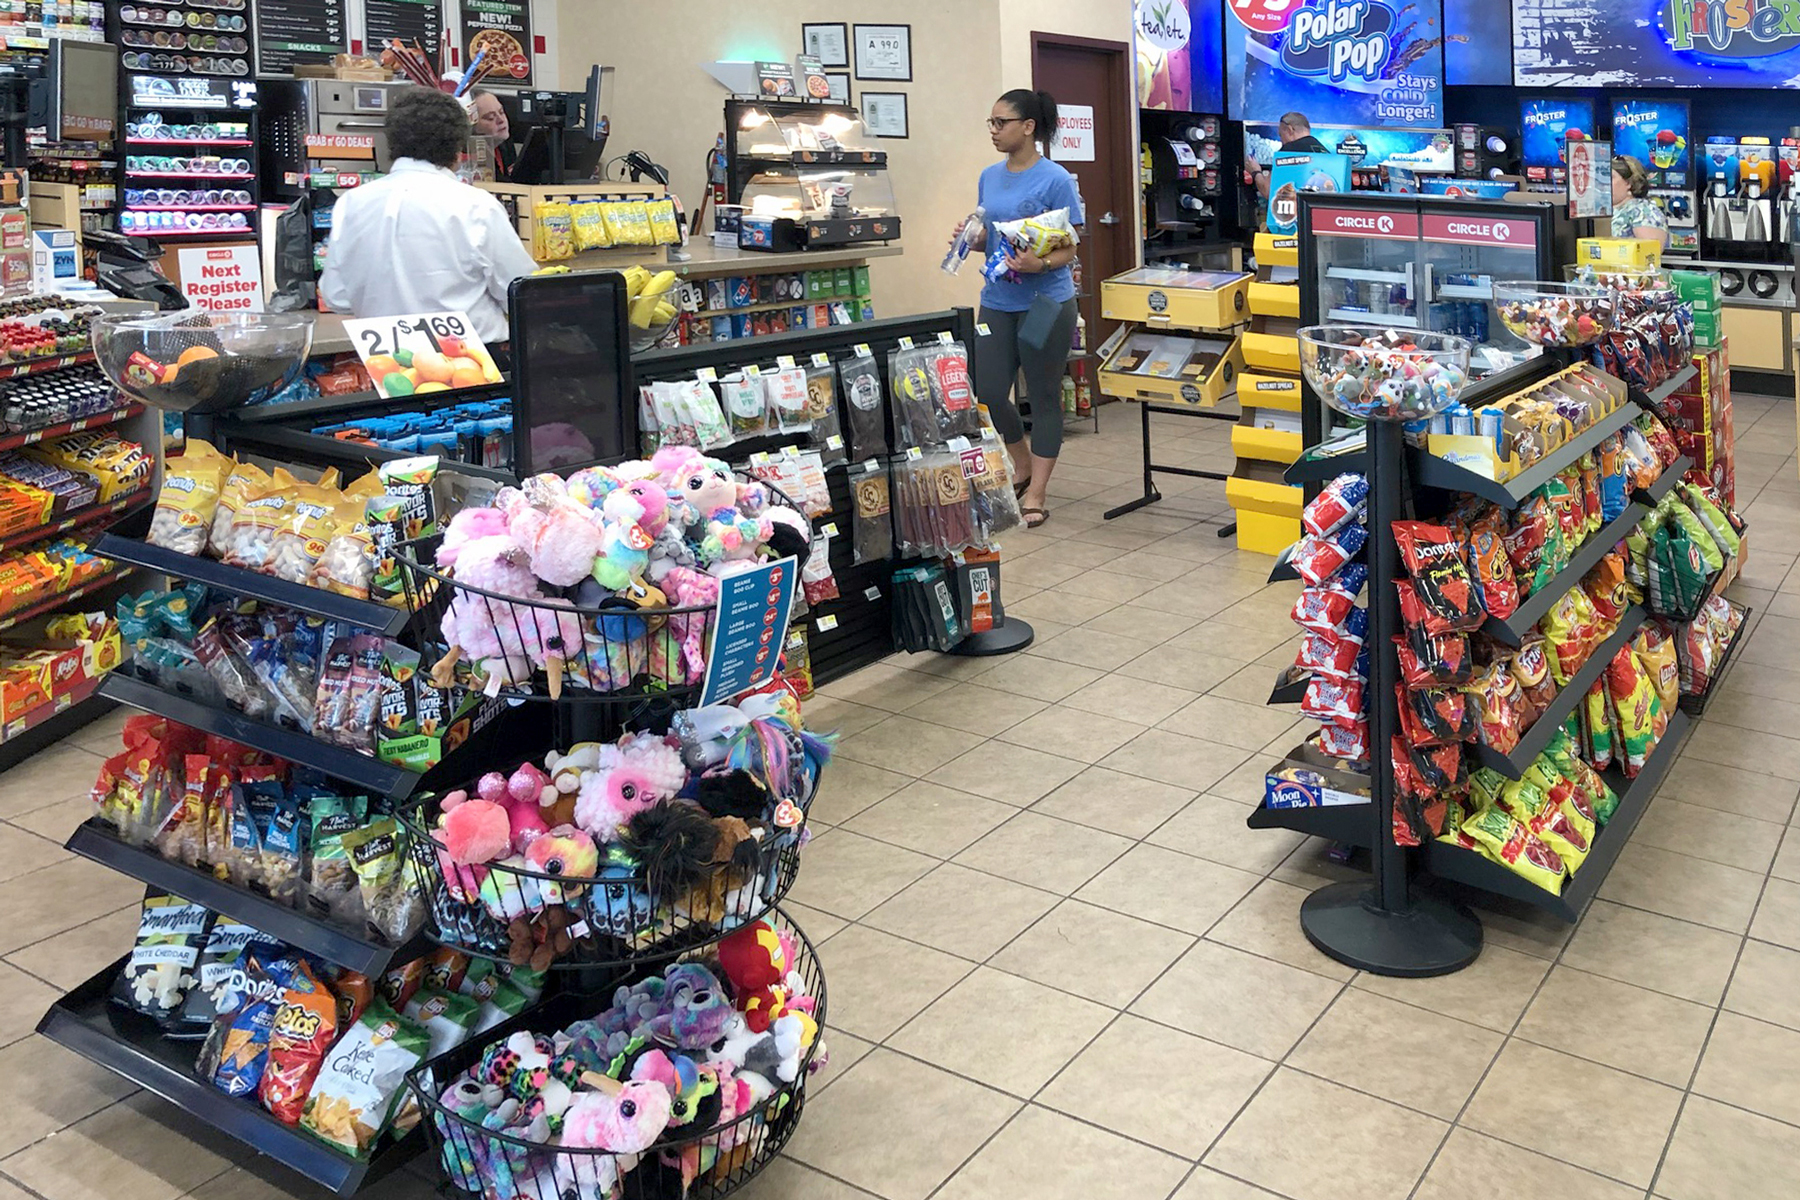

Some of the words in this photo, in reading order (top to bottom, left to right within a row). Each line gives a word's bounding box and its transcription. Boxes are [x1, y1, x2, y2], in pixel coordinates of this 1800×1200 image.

[467, 0, 504, 10] FEATURED
[479, 12, 512, 24] NEW!
[1251, 13, 1265, 21] Any
[1293, 0, 1363, 47] Polar
[467, 21, 504, 30] PEPPERONI
[287, 43, 322, 51] SNACKS
[868, 40, 876, 49] A
[1332, 36, 1386, 77] Pop
[1398, 74, 1436, 92] Stays
[1382, 90, 1423, 103] COLD
[1378, 104, 1436, 121] Longer!
[1525, 111, 1566, 124] FROSTER
[1614, 112, 1658, 125] FROSTER
[306, 135, 326, 145] GRAB
[335, 137, 346, 147] GO
[347, 138, 374, 147] DEALS!
[1062, 137, 1081, 148] ONLY
[1277, 199, 1294, 214] m
[1335, 216, 1375, 229] CIRCLE
[1447, 222, 1490, 236] CIRCLE
[54, 255, 74, 265] ZYN
[201, 264, 241, 278] Next
[186, 280, 258, 297] Register
[196, 297, 251, 311] Please
[164, 476, 196, 493] Peanuts
[1415, 541, 1460, 561] Doritos
[971, 570, 988, 580] CHEF'S
[734, 578, 751, 588] BEANIE
[734, 586, 744, 594] BOO
[745, 583, 755, 591] CLIP
[973, 579, 988, 592] CUT
[731, 606, 748, 615] BEANIE
[749, 602, 759, 610] BOO
[732, 600, 747, 609] SMALL
[728, 625, 745, 636] BEANIE
[746, 622, 756, 630] BOO
[729, 620, 745, 629] LARGE
[724, 641, 754, 656] CHARACTERS
[725, 638, 748, 650] LICENSED
[722, 658, 738, 667] SMALL
[473, 700, 508, 734] SHOTS
[397, 738, 430, 754] HABANERO
[1272, 790, 1301, 804] Moon
[321, 822, 356, 831] HARVEST
[354, 842, 392, 861] HARVEST
[140, 904, 204, 930] Smartfood
[155, 948, 190, 960] CHEDDAR
[229, 969, 288, 1006] Doritos
